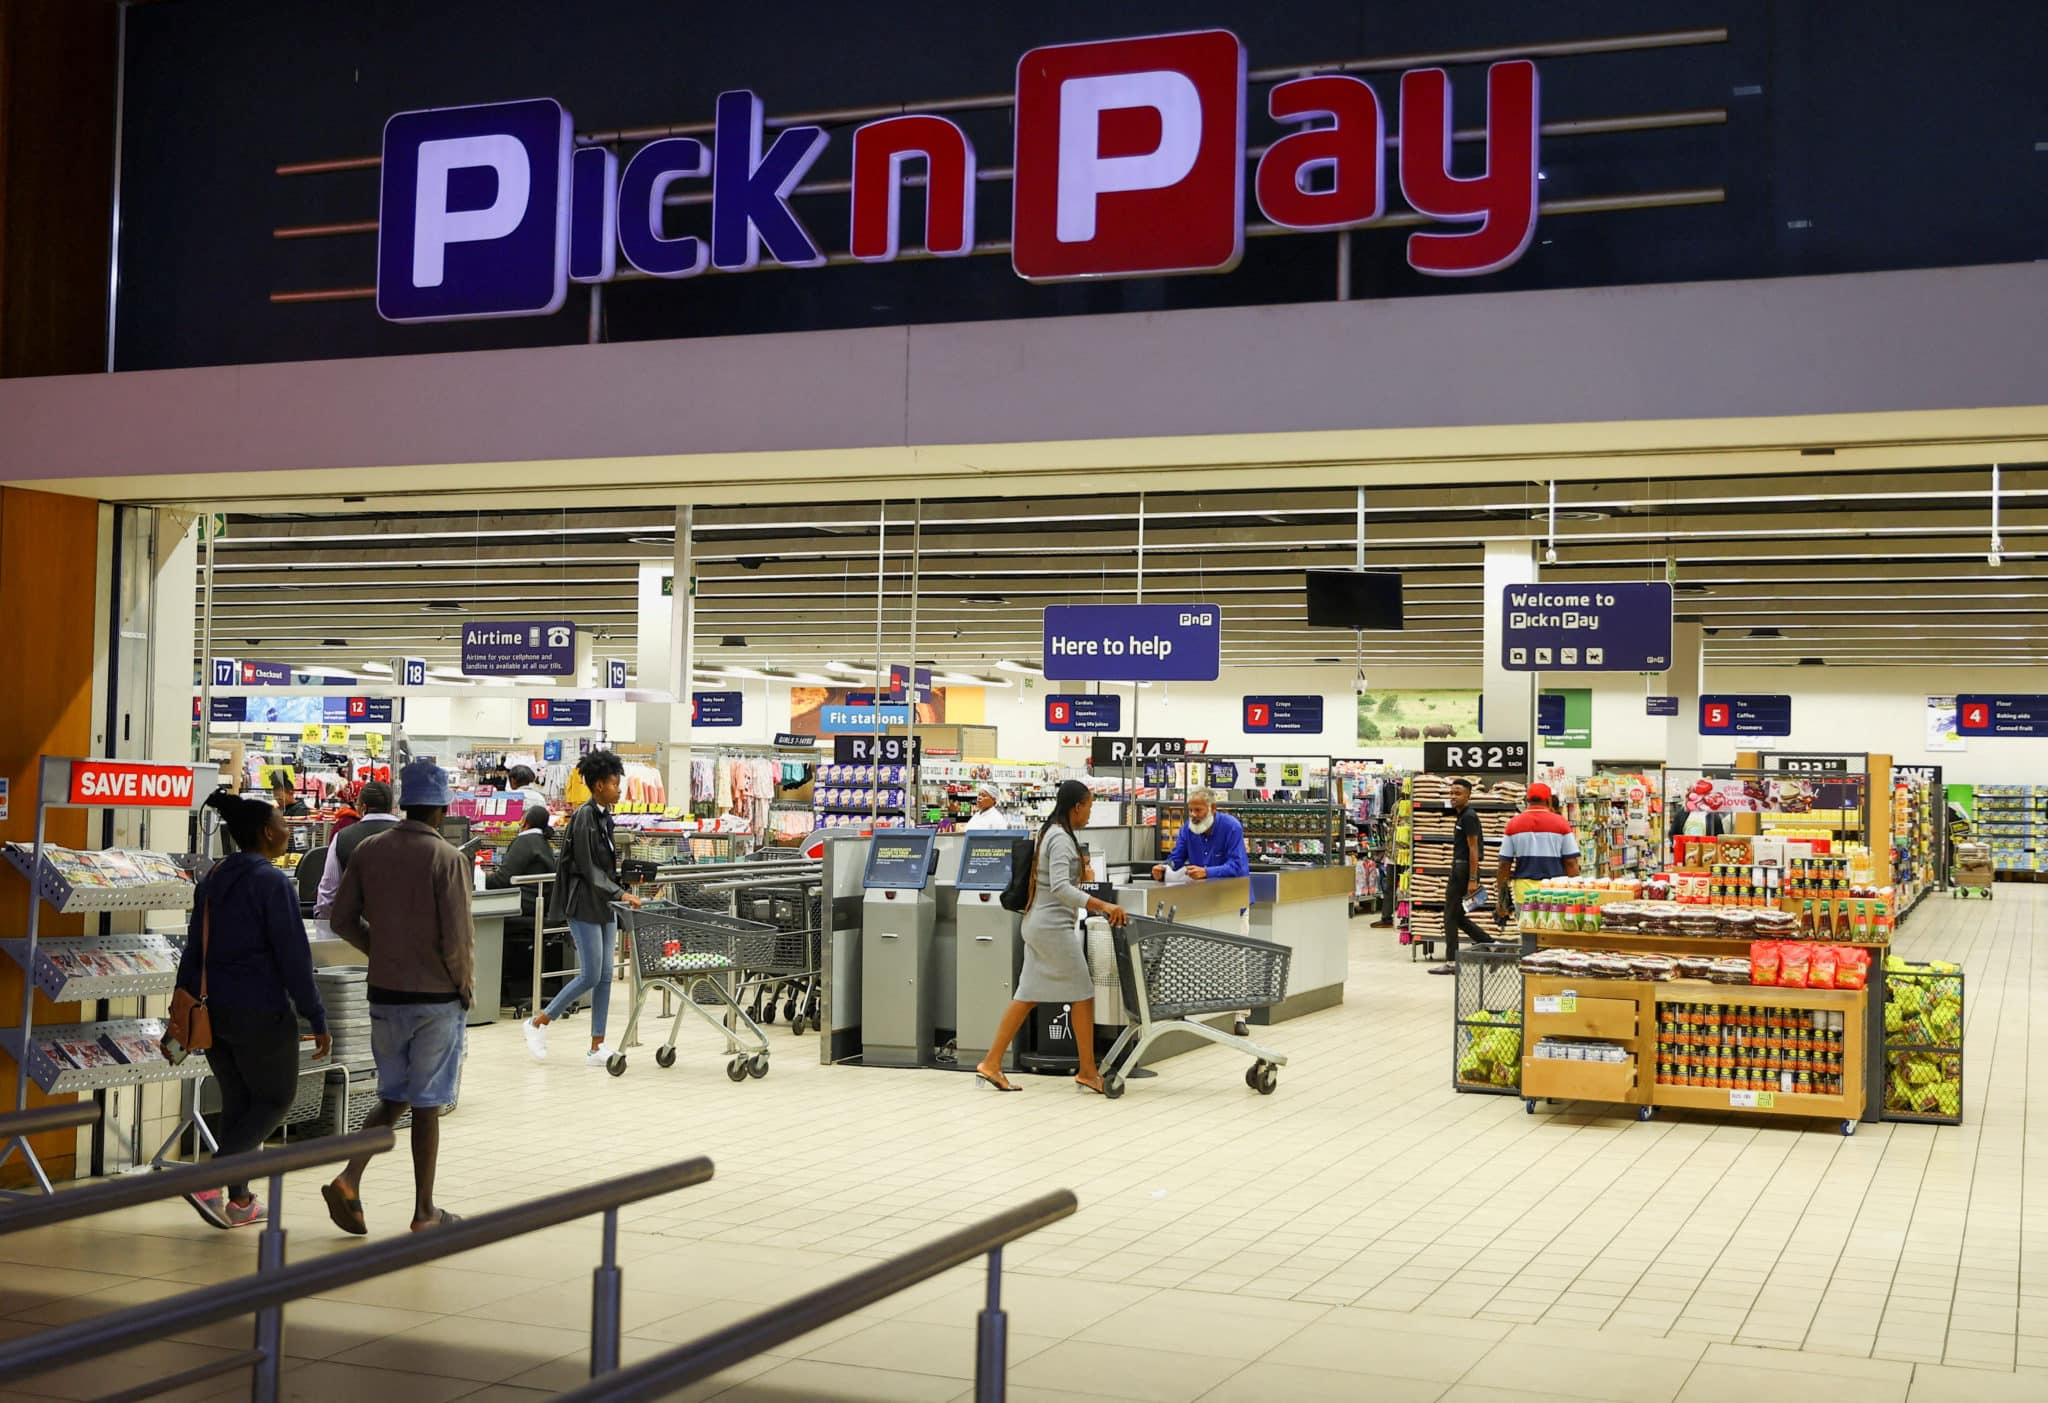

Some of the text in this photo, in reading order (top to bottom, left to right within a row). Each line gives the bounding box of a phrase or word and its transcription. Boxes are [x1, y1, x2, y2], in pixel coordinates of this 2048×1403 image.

[376, 28, 1542, 322] Pick n Pay
[1511, 592, 1615, 607] Welcome to
[1180, 613, 1212, 626] PnP
[1510, 612, 1548, 629] Pick
[1562, 612, 1600, 630] Pay
[466, 630, 523, 645] Airtime
[1052, 635, 1172, 660] Here to help
[512, 653, 540, 661] cellphone
[466, 662, 488, 670] landline
[489, 662, 495, 670] is
[496, 662, 520, 670] available
[217, 665, 232, 682] 17
[255, 669, 283, 680] Checkout
[408, 665, 422, 683] 18
[611, 666, 624, 685] 19
[352, 702, 363, 713] 12
[534, 703, 545, 715] 11
[1054, 707, 1064, 719] 8
[1253, 708, 1262, 721] 7
[830, 712, 905, 725] Fit stations
[1711, 709, 1721, 722] 5
[1969, 709, 1981, 723] 4
[1996, 712, 2017, 720] Baking
[852, 740, 899, 759] R49
[1112, 741, 1181, 761] R44 99
[1447, 746, 1524, 768] R32 99
[81, 771, 193, 798] SAVE NOW
[1724, 798, 1747, 806] love
